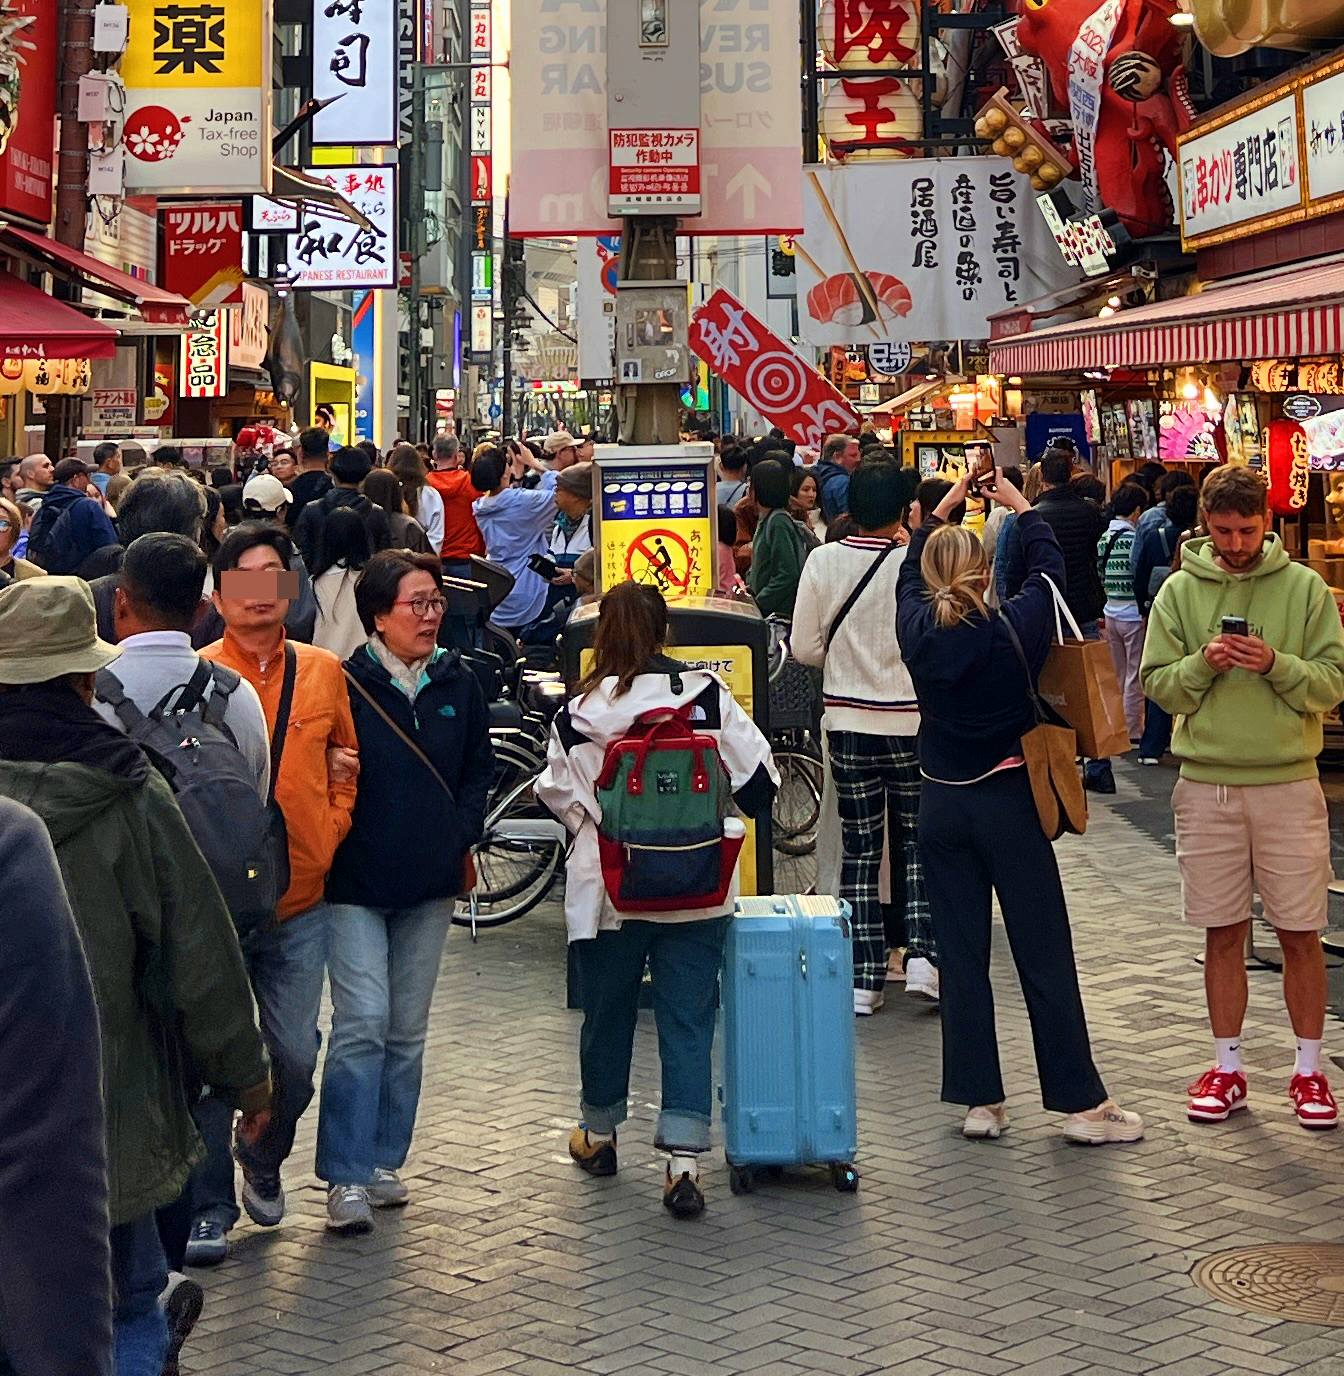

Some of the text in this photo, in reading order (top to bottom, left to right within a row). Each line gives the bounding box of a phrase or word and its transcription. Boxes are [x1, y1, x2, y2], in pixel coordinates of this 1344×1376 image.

[153, 4, 225, 74] 薬
[1080, 29, 1106, 58] 2025
[198, 126, 258, 142] Tax-free
[476, 106, 487, 151] NYNY
[613, 132, 695, 148] 防犯監視カメラ
[219, 142, 258, 160] Shop
[635, 149, 673, 164] 作動中
[1194, 126, 1280, 216] 串カツ専門店
[169, 210, 240, 234] ツルハ
[910, 177, 939, 269] 居酒屋
[169, 238, 227, 256] ドラッグ
[296, 220, 388, 266] 和食
[1291, 432, 1309, 510] たこ焼き
